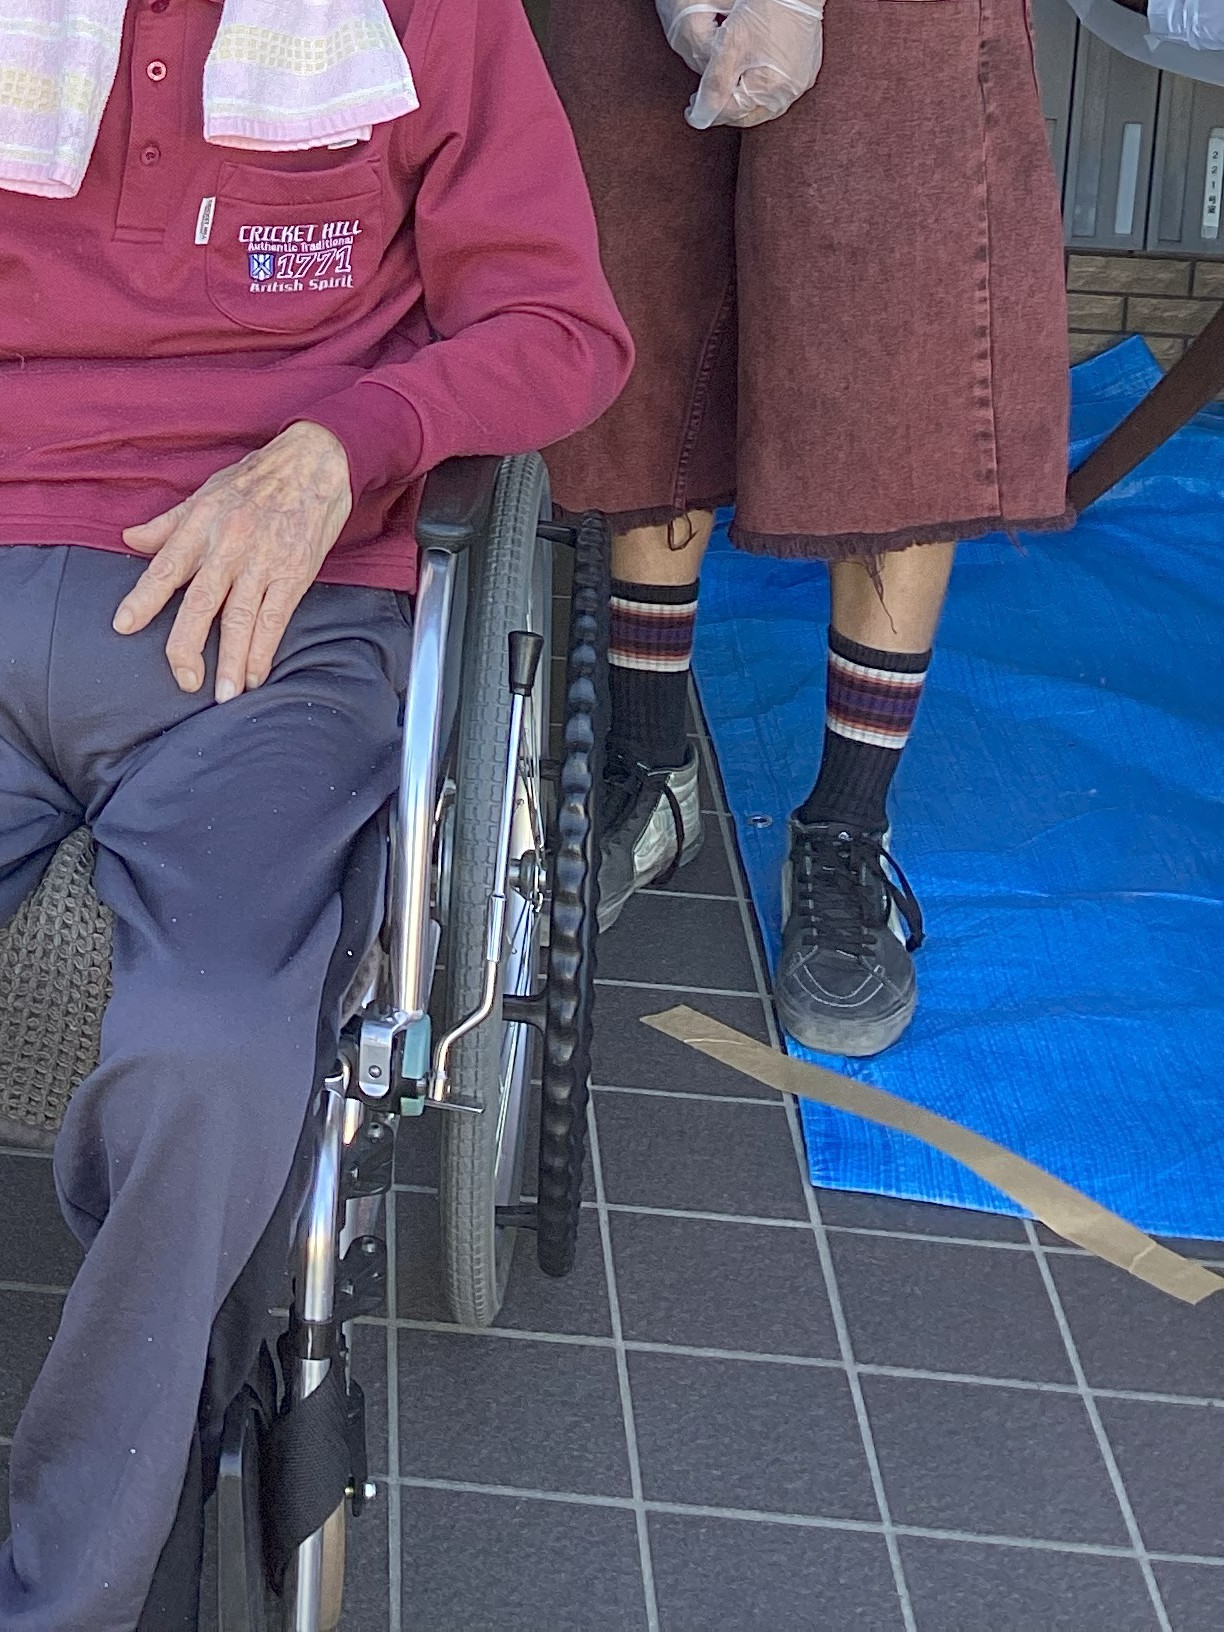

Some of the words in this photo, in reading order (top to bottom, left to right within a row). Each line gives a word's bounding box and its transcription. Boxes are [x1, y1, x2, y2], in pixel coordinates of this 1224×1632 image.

[238, 225, 318, 243] CRICKET
[322, 219, 363, 239] HILL
[248, 241, 298, 252] Authentic
[301, 236, 354, 251] Traditional
[277, 244, 353, 279] 1771
[309, 275, 355, 291] Spirit
